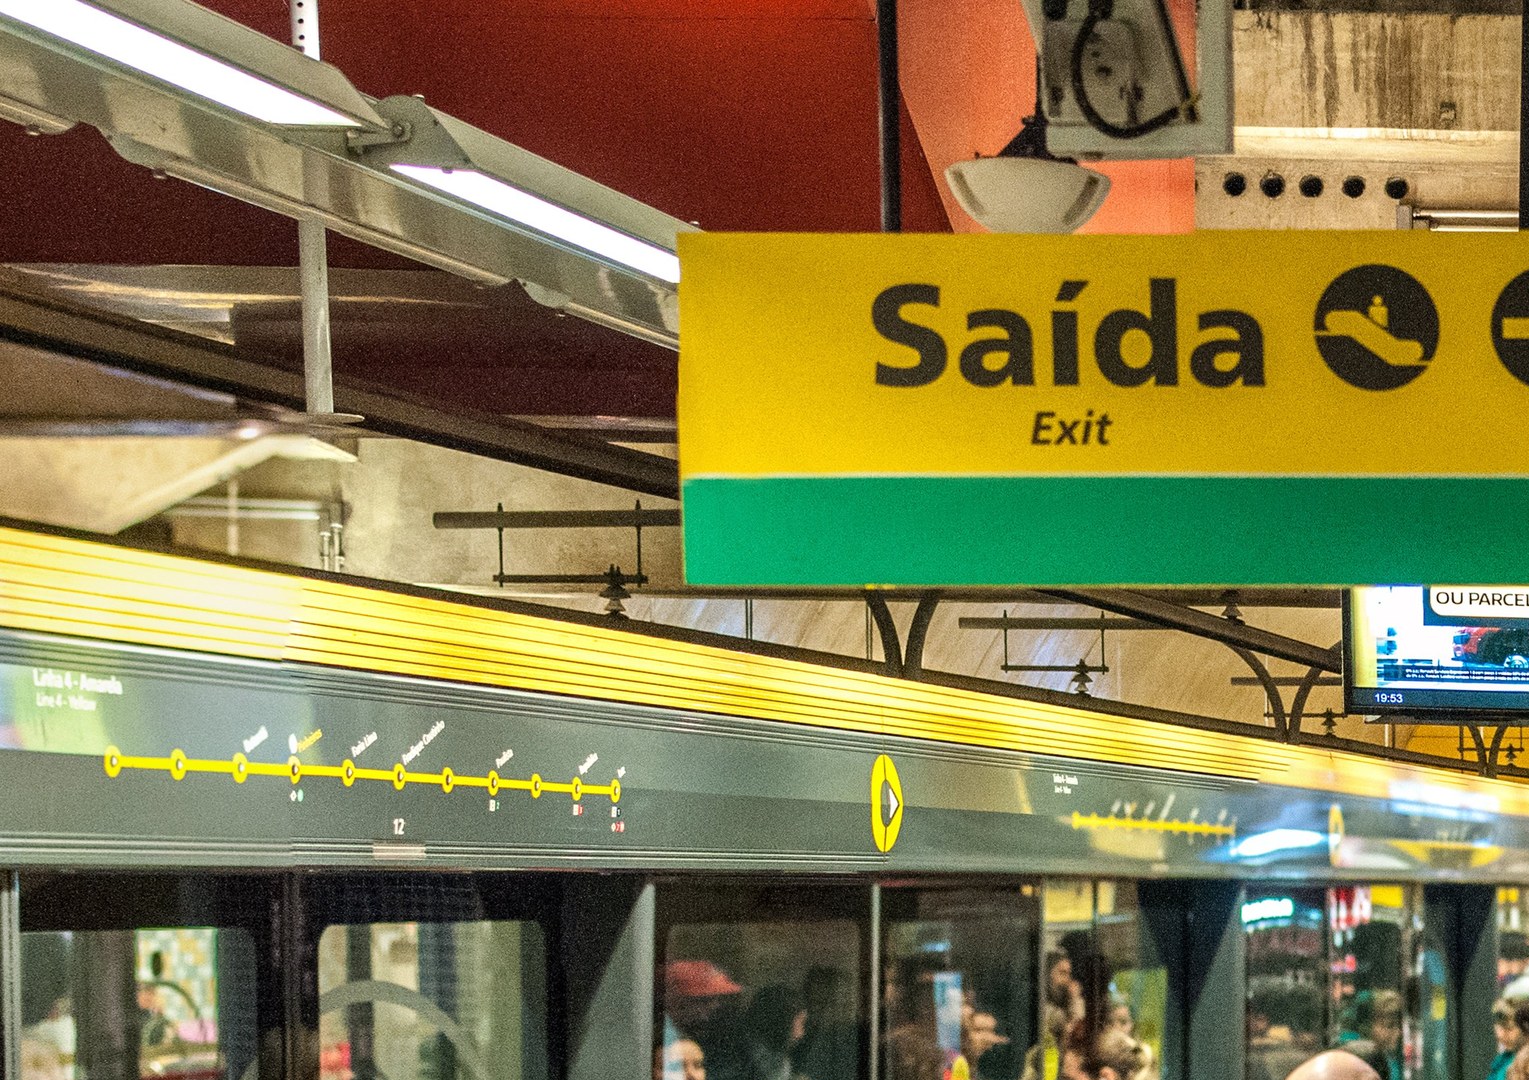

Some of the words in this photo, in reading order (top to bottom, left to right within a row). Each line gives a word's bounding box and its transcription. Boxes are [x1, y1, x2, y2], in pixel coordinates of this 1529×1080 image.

[872, 277, 1266, 389] Saída
[1031, 412, 1112, 446] Exit
[1435, 591, 1465, 605] OU
[1374, 692, 1404, 704] 19:53
[393, 818, 406, 835] 12
